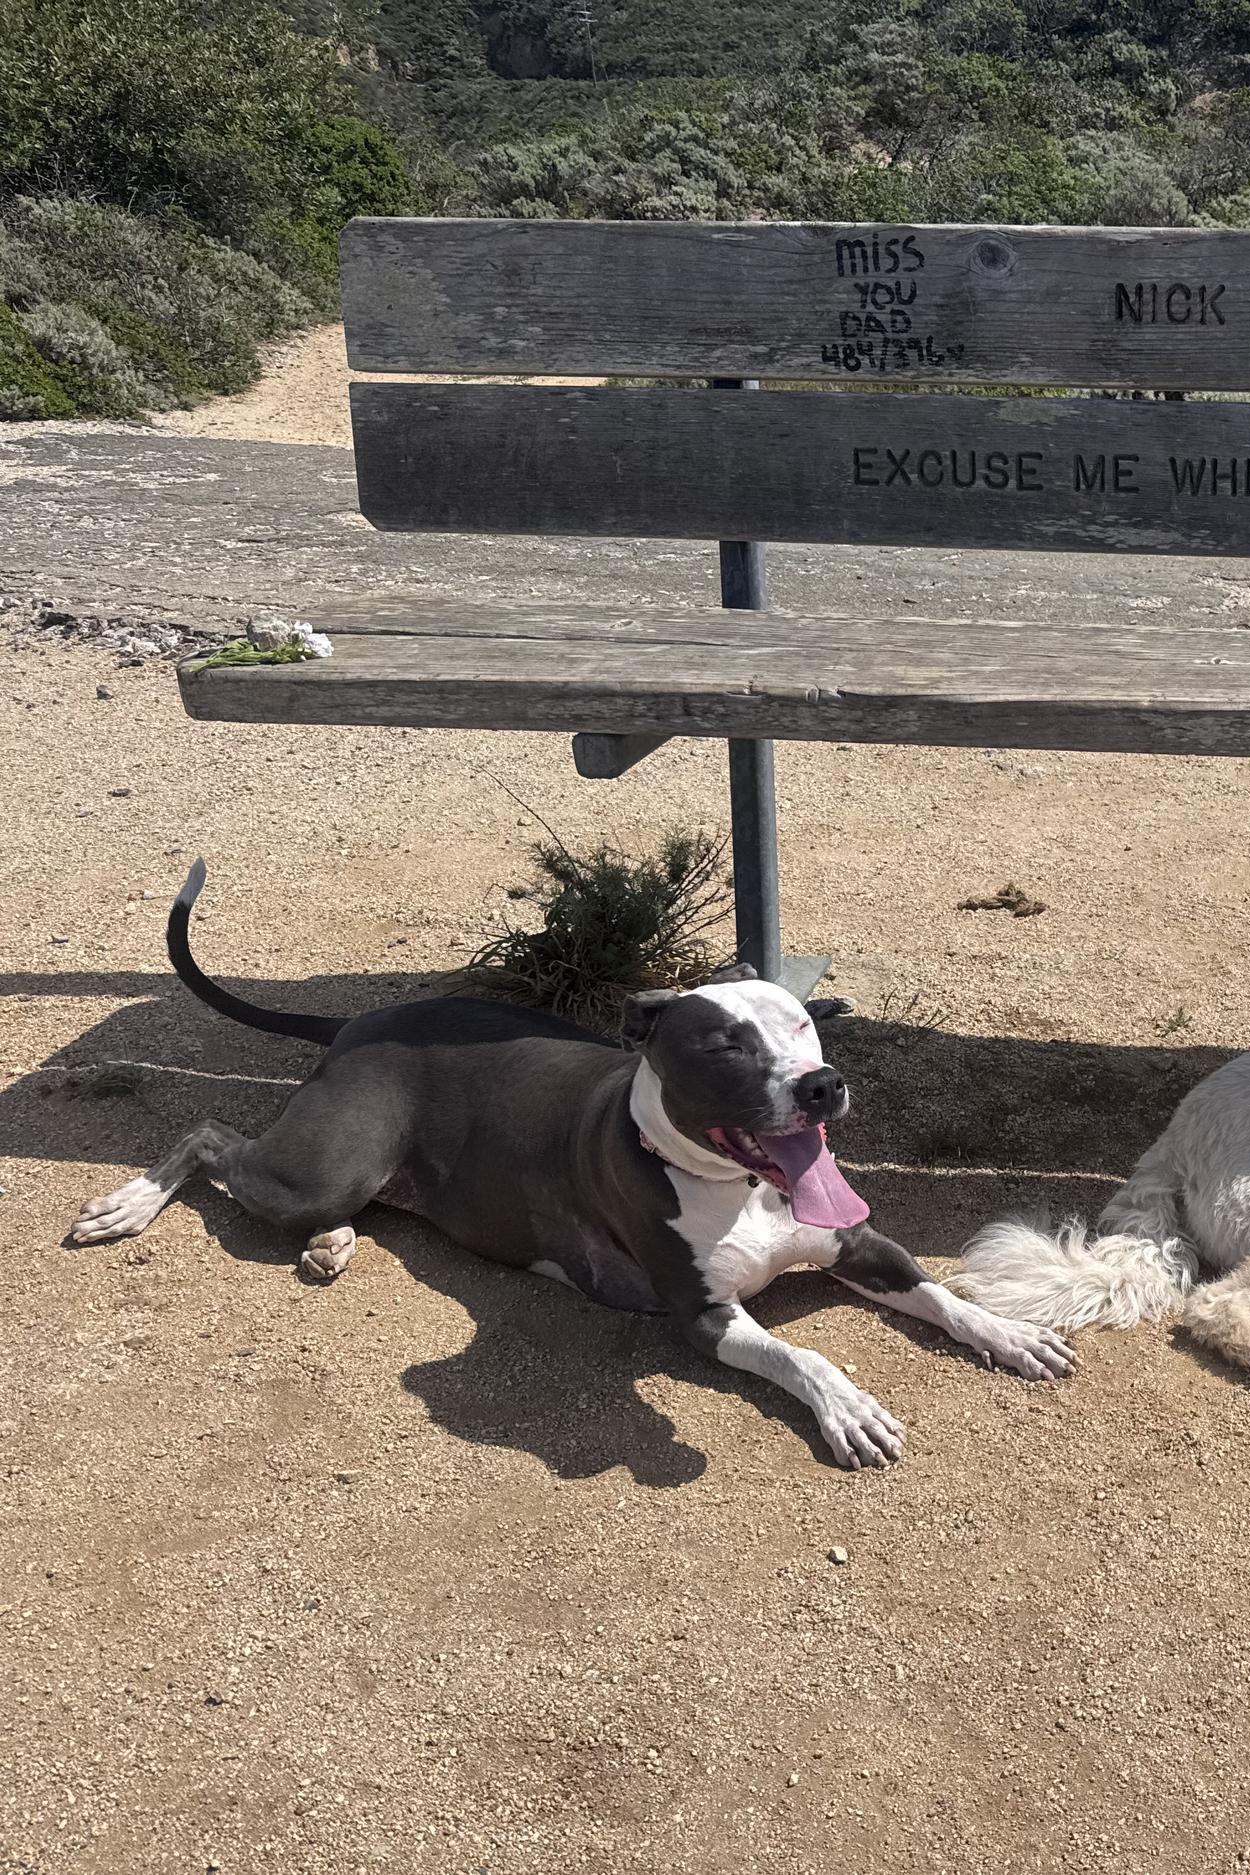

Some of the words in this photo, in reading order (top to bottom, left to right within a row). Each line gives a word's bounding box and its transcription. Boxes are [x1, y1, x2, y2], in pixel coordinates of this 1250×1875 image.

[853, 278, 918, 311] YOU
[1113, 281, 1227, 326] NICK
[838, 308, 913, 339] DAD
[852, 446, 1044, 491] EXCUSE
[1072, 453, 1140, 494] ME
